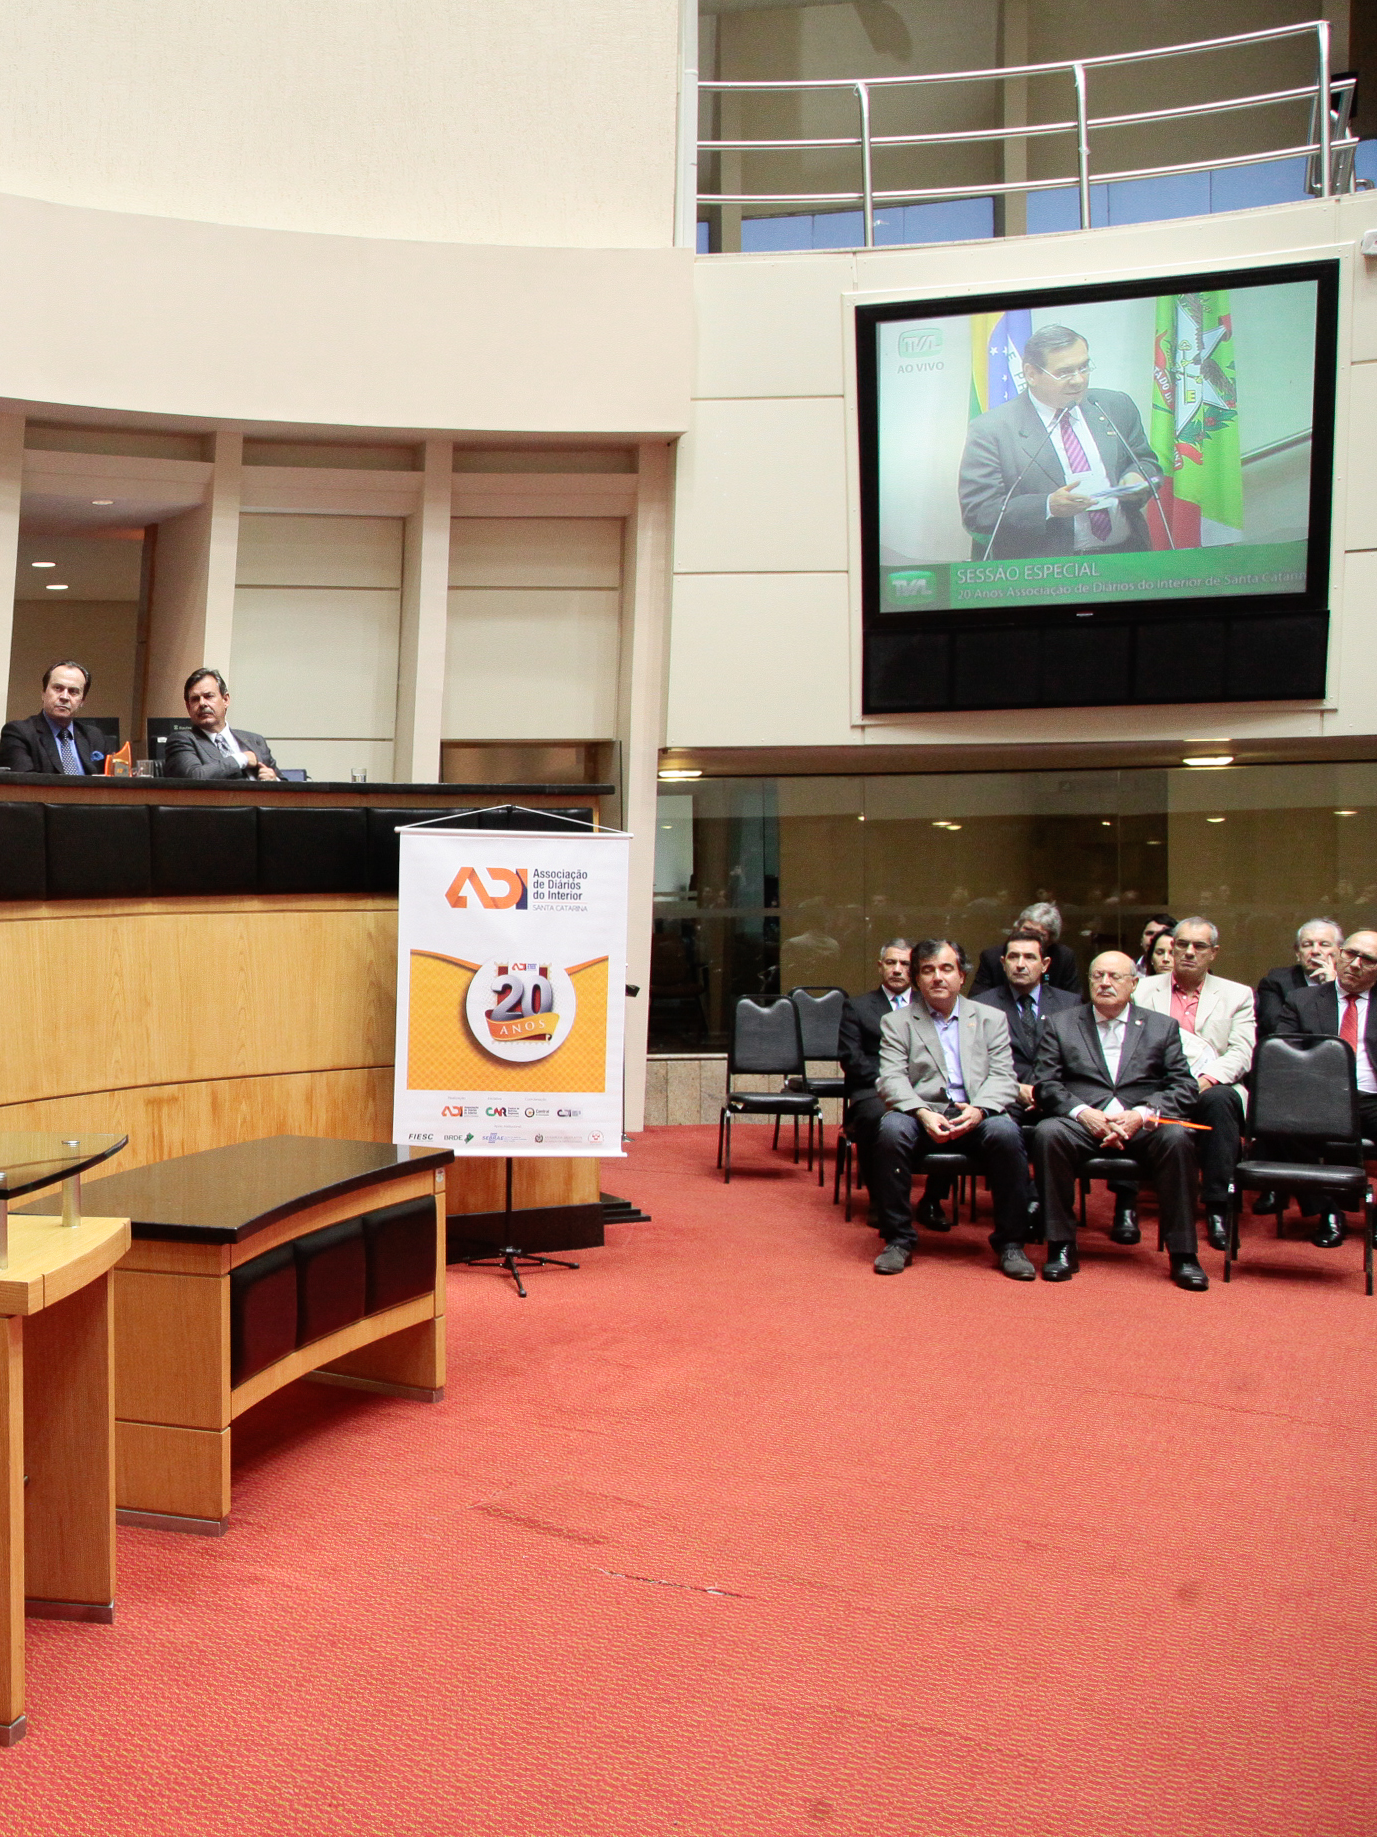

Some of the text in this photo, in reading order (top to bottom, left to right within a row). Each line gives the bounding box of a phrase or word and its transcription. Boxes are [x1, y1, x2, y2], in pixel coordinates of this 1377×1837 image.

[897, 361, 945, 374] AO VIVO
[957, 562, 1100, 584] SESSÃO ESPECIAL
[974, 588, 1003, 599] Anos
[1007, 583, 1071, 599] Associação
[1075, 583, 1089, 594] de
[1092, 580, 1135, 594] Diários
[1137, 579, 1154, 590] do
[1157, 577, 1202, 590] Interior
[1205, 575, 1221, 586] de
[1224, 573, 1259, 586] Santa
[533, 868, 588, 881] Associação
[445, 866, 528, 910] ADI
[533, 879, 581, 890] de Diários
[533, 890, 583, 901] do Interior
[532, 904, 588, 912] SANTA CATARINA
[491, 974, 553, 1022] 20
[499, 1019, 546, 1036] ANOS
[408, 1133, 434, 1141] FIESC
